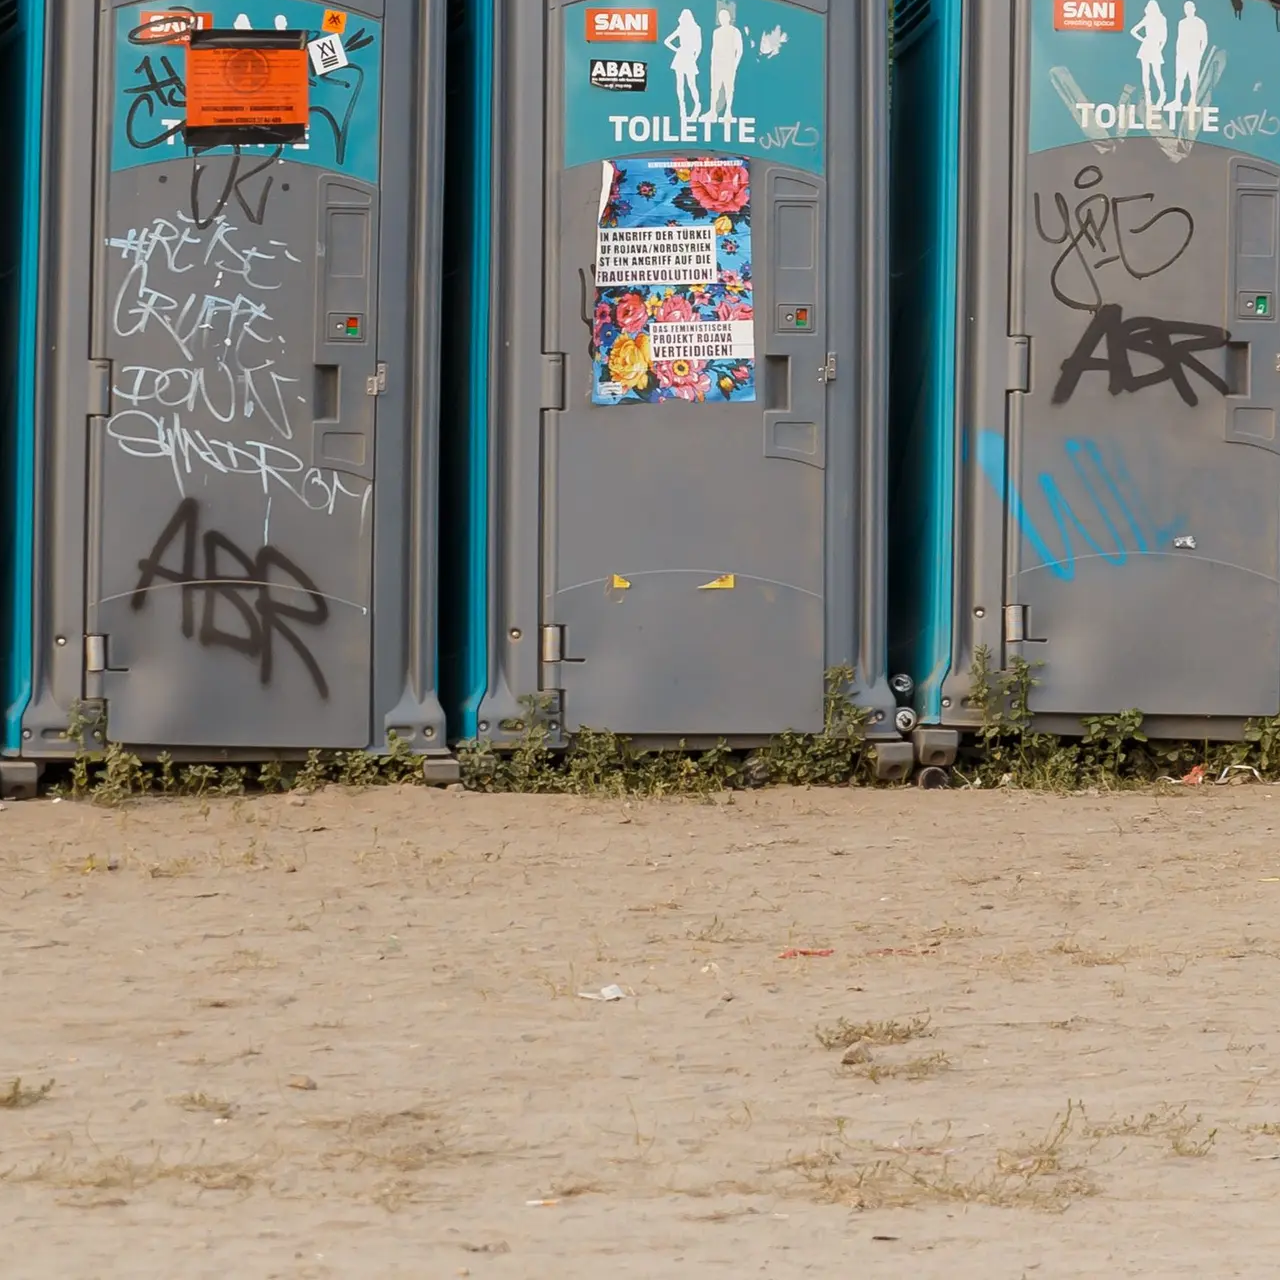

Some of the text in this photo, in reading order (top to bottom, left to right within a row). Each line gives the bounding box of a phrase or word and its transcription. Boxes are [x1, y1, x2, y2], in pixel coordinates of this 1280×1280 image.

[1063, 1, 1115, 18] SANI
[594, 13, 648, 30] SANI
[591, 61, 645, 77] ABAB
[1076, 102, 1220, 132] TOILETTE
[609, 115, 756, 142] TOILETTE
[612, 231, 653, 241] ANGRIFF
[656, 230, 674, 240] DER
[677, 228, 711, 240] TÜRKEI
[614, 243, 711, 254] ROJAVA/NORDSYRIEN
[613, 257, 629, 266] EIN
[632, 256, 671, 266] ANGRIFF
[675, 255, 692, 265] AUF
[696, 254, 711, 265] DIE
[597, 268, 713, 283] FRAUENREVOLUTION!
[653, 323, 732, 333] DAS FEMINISTISCHE
[653, 333, 733, 344] PROJEKT ROJAVA
[653, 344, 733, 358] VERTEIDIGEN!
